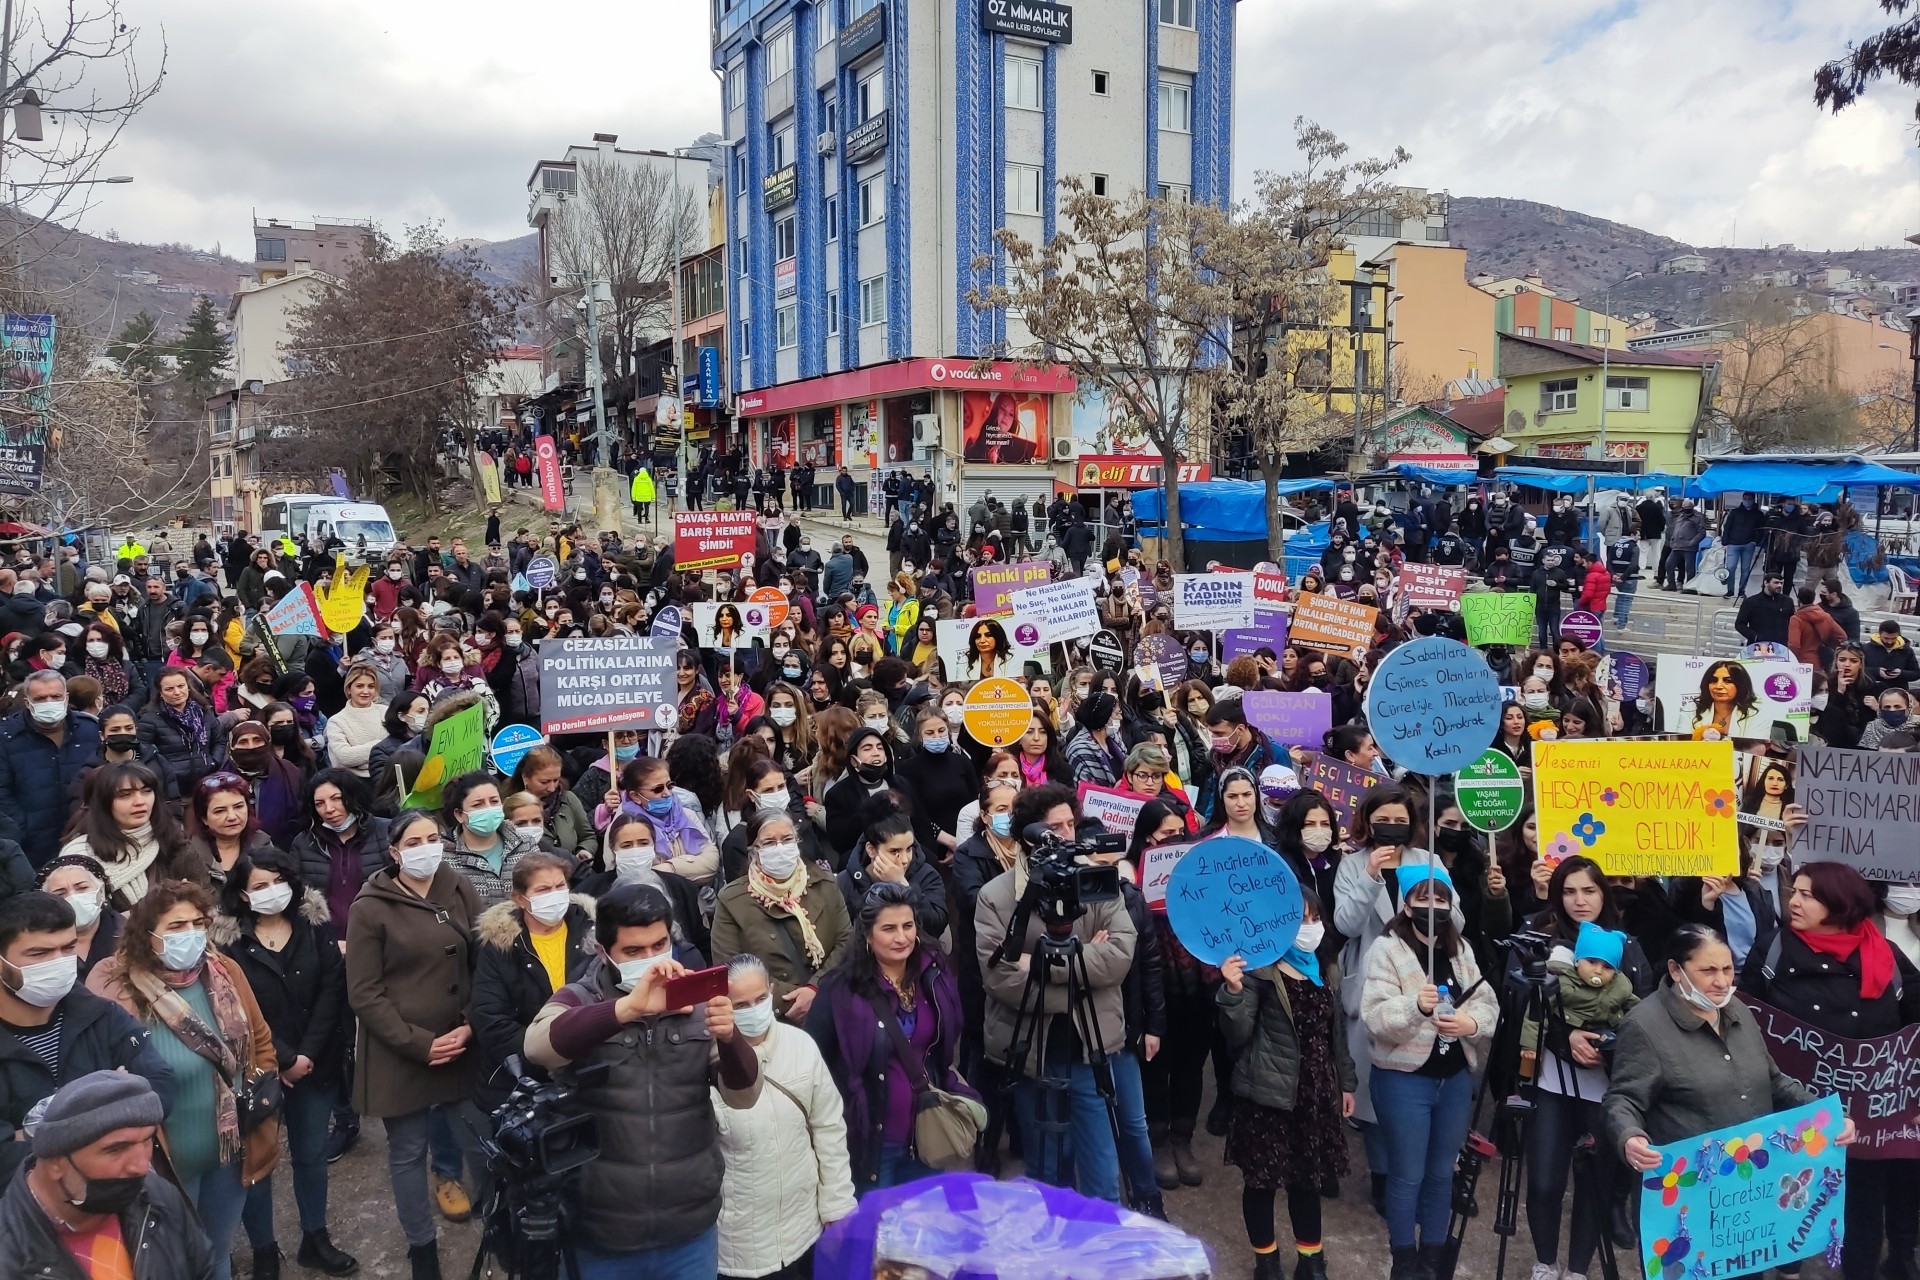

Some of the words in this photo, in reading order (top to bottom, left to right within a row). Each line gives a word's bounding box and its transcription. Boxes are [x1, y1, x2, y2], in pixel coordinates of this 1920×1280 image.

[1010, 1, 1069, 28] MİMARLIK
[996, 19, 1015, 28] MİMAR
[1015, 22, 1032, 32] İLKER
[1032, 26, 1062, 37] SÖYLEMEZ
[777, 165, 794, 184] HUKUK
[706, 379, 714, 399] ELMA
[1423, 420, 1455, 444] PAZARI
[1101, 466, 1129, 483] elif
[676, 513, 719, 526] SAVAŞA
[720, 512, 755, 523] HAYIR,
[680, 527, 713, 539] BARIŞ
[715, 525, 752, 536] HEMEN
[698, 538, 734, 552] ŞİMDİ!
[1023, 567, 1048, 584] pia
[1403, 563, 1435, 575] EŞİT
[1437, 566, 1462, 579] İŞE
[1025, 589, 1037, 598] Ne
[1038, 582, 1075, 597] Hastalık,
[1183, 580, 1243, 593] KADIN
[1257, 577, 1285, 594] DOKU
[1404, 582, 1457, 598] ÜCRET!
[1415, 575, 1448, 587] EŞİT
[1016, 602, 1028, 611] Ne
[1029, 599, 1047, 610] Suç,
[1047, 595, 1058, 604] Ne
[1060, 588, 1089, 602] Günah!
[1183, 590, 1243, 600] KADININ
[1465, 594, 1516, 614] DENİZ
[1052, 600, 1088, 614] HAKLARI
[1310, 597, 1338, 611] ŞİDDET
[1338, 603, 1350, 613] VE
[1349, 605, 1367, 618] HAK
[1298, 605, 1349, 626] İHLALLERİNE
[1347, 619, 1373, 633] KARŞI
[1293, 618, 1319, 632] ORTAK
[1319, 624, 1372, 644] MÜCADELEYE
[562, 638, 655, 652] CEZASIZLIK
[543, 655, 674, 671] POLİTİKALARINA
[1400, 645, 1467, 666] Sabahlara
[1685, 661, 1704, 669] HDP
[557, 675, 606, 690] KARŞI
[610, 673, 662, 687] ORTAK
[1436, 666, 1489, 684] Olanların
[557, 690, 663, 707] MÜCADELEYE
[1442, 688, 1502, 710] Mücadeleye
[547, 723, 560, 733] İHD
[561, 718, 587, 731] Dersim
[587, 714, 607, 726] Kadın
[608, 711, 645, 723] Komisyonu
[1393, 721, 1423, 740] Yeni
[1432, 711, 1485, 736] Demokrat
[437, 726, 455, 755] EM
[1424, 742, 1462, 760] Kadın
[1618, 757, 1713, 770] ÇALANLARDAN
[1472, 800, 1483, 808] VE
[1482, 799, 1508, 807] DOĞAYI
[1475, 790, 1500, 799] YAŞAMI
[1540, 780, 1602, 810] HESAP
[1618, 780, 1705, 810] SORMAYA
[1088, 796, 1131, 813] Emperyalizm
[1467, 808, 1515, 817] SAVUNUYORUZ
[1747, 815, 1768, 826] GÜZEL
[1636, 818, 1704, 851] GELDİK
[1791, 824, 1876, 857] AFFINA
[1196, 850, 1270, 876] Zincirlerini
[1605, 852, 1645, 873] DERSİM
[1646, 851, 1685, 873] YENİGÜN
[1686, 854, 1714, 873] KADIN
[1179, 883, 1209, 902] Kır
[1228, 871, 1286, 895] Geleceği
[1220, 898, 1253, 916] Kur
[1199, 926, 1233, 949] Yeni
[1239, 903, 1301, 938] Demokrat
[1233, 937, 1280, 956] Kadın
[1709, 1180, 1775, 1209] Ücretsiz
